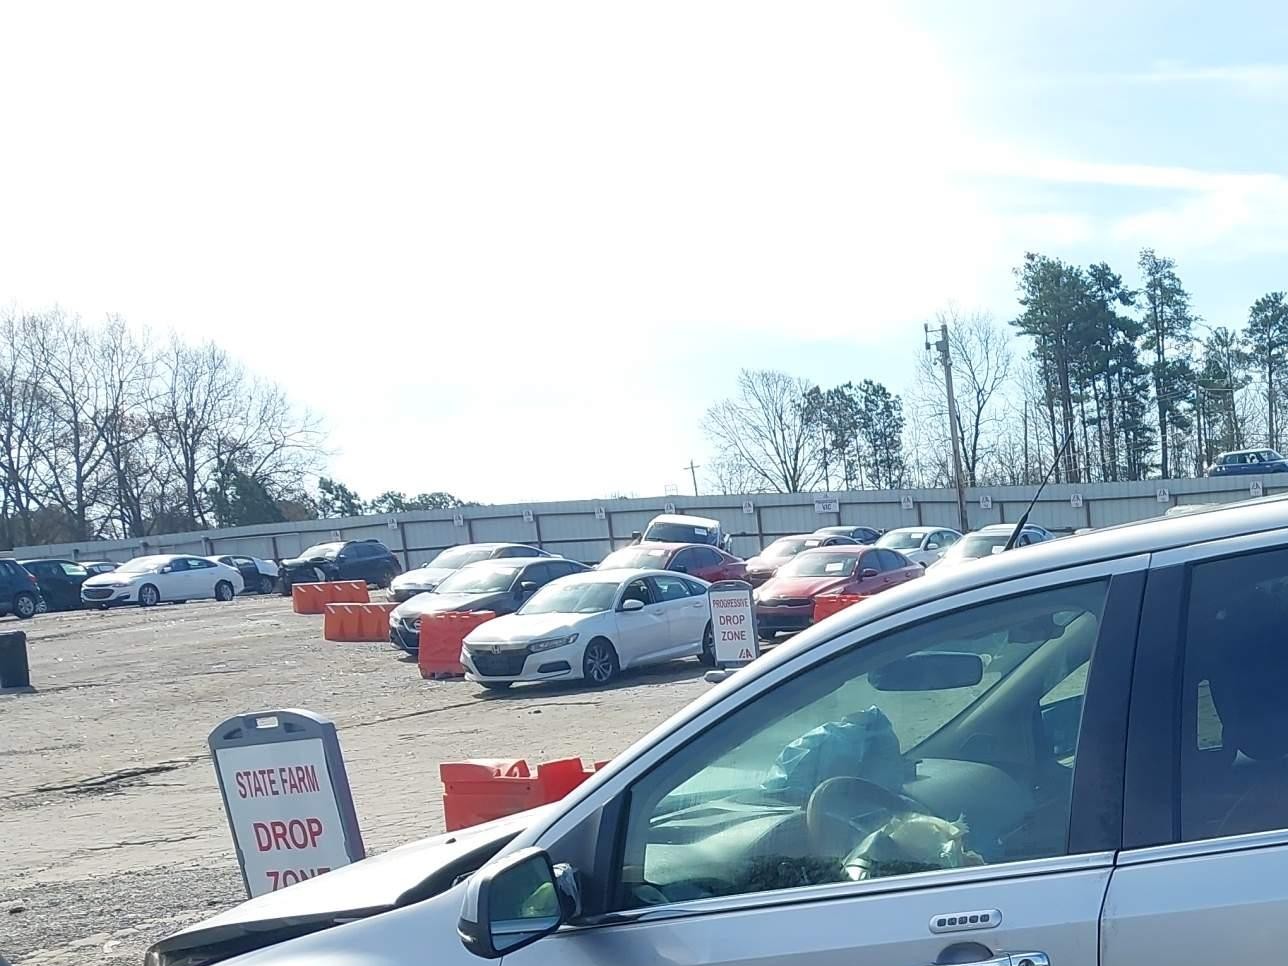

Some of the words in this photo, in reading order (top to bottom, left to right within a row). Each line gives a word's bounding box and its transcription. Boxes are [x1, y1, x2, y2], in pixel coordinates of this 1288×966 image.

[719, 615, 745, 625] DROP
[721, 631, 746, 641] ZONE
[235, 769, 279, 798] STATE
[279, 765, 320, 795] FARM
[253, 818, 323, 851] DROP
[266, 868, 330, 891] ZO
